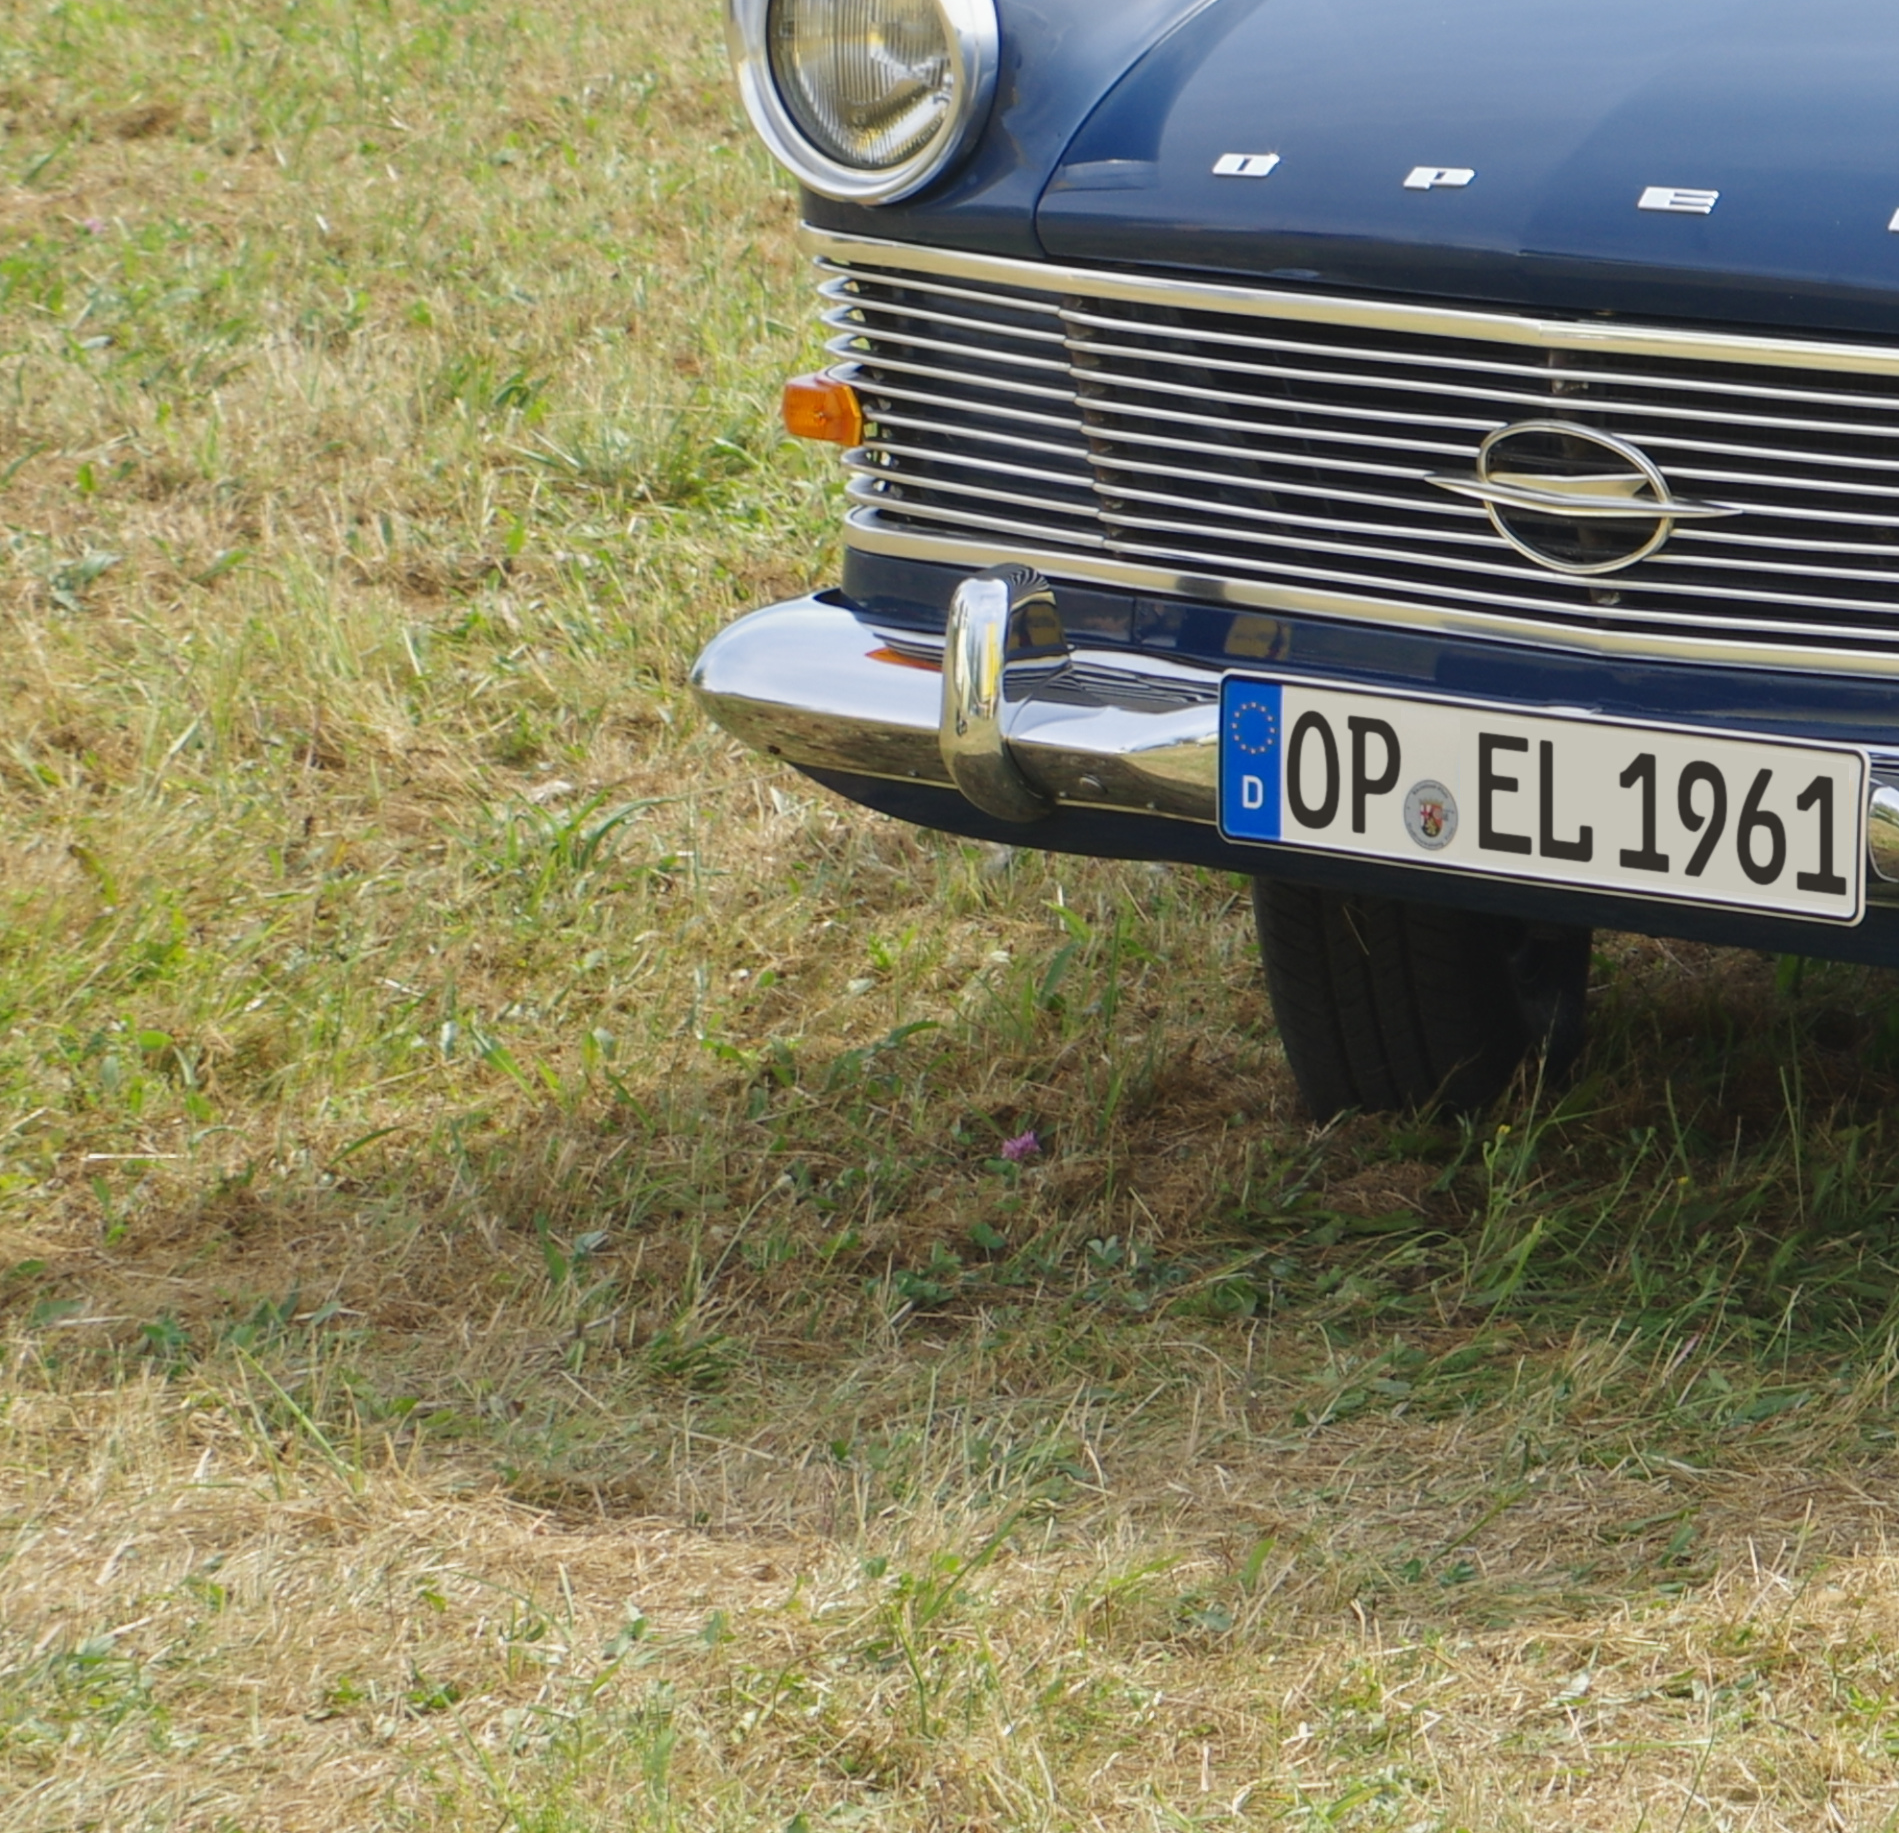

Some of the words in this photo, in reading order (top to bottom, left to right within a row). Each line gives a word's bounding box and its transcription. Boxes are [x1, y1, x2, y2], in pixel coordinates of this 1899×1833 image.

[1242, 775, 1263, 809] D
[1287, 710, 1401, 834] OP
[1479, 732, 1593, 862] EL
[1619, 753, 1847, 895] 1961
